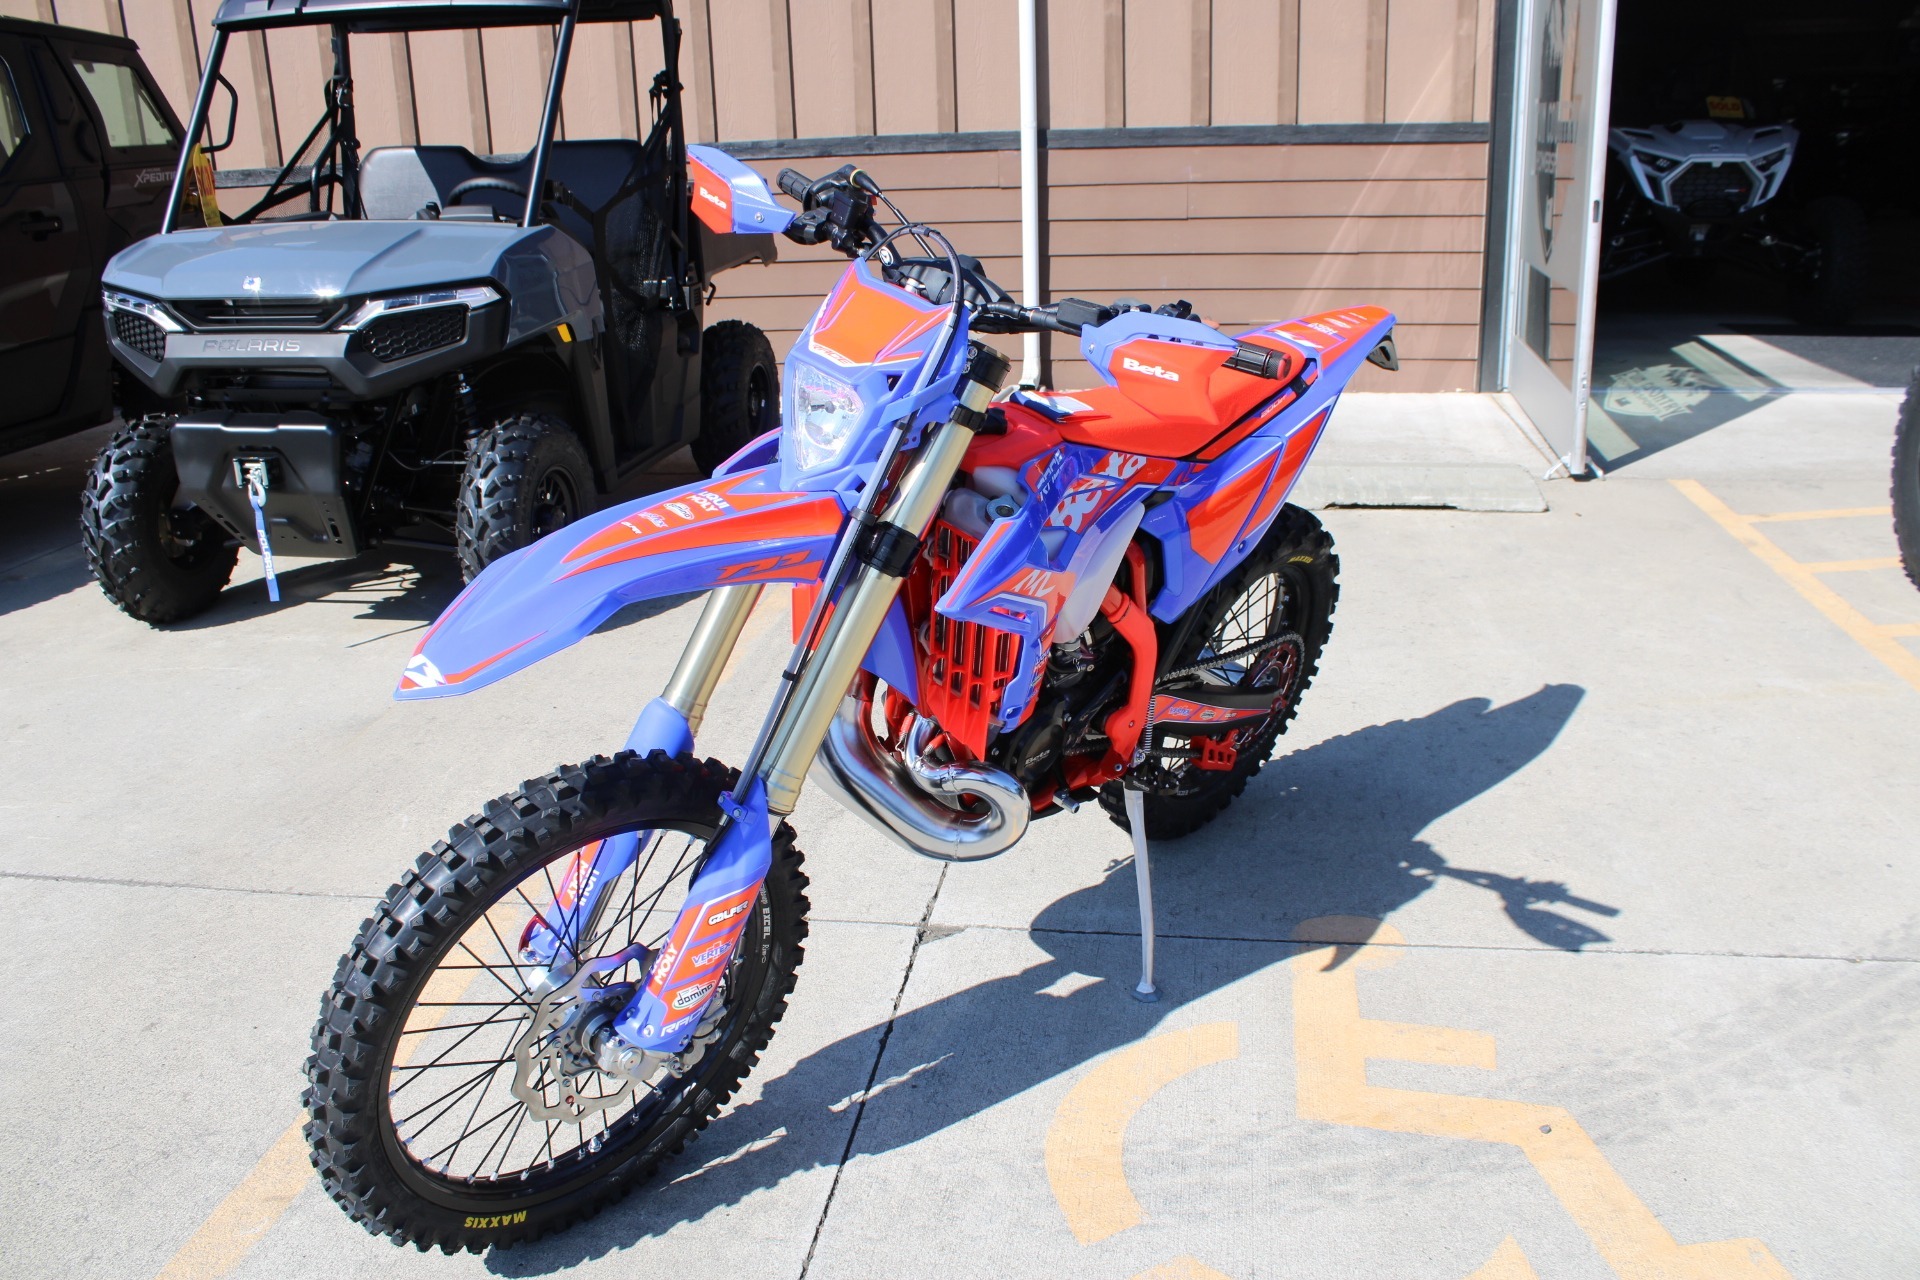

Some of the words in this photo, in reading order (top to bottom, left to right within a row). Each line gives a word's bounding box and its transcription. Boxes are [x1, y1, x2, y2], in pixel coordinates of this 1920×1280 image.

[699, 186, 727, 210] Beta
[202, 338, 301, 353] POLARIS
[1122, 357, 1180, 382] Beta
[686, 494, 719, 513] MOLY
[697, 489, 730, 510] LIQUI
[1049, 452, 1148, 534] Beta
[257, 530, 275, 580] POLARIS
[1286, 555, 1313, 564] MAXXIS
[1025, 749, 1050, 765] Beta
[708, 900, 749, 927] GALFER
[762, 906, 771, 940] EXCEL
[654, 943, 679, 985] MOLY
[691, 941, 734, 966] VERTEX
[677, 983, 714, 1006] domino
[463, 1210, 527, 1229] MAXXIS
